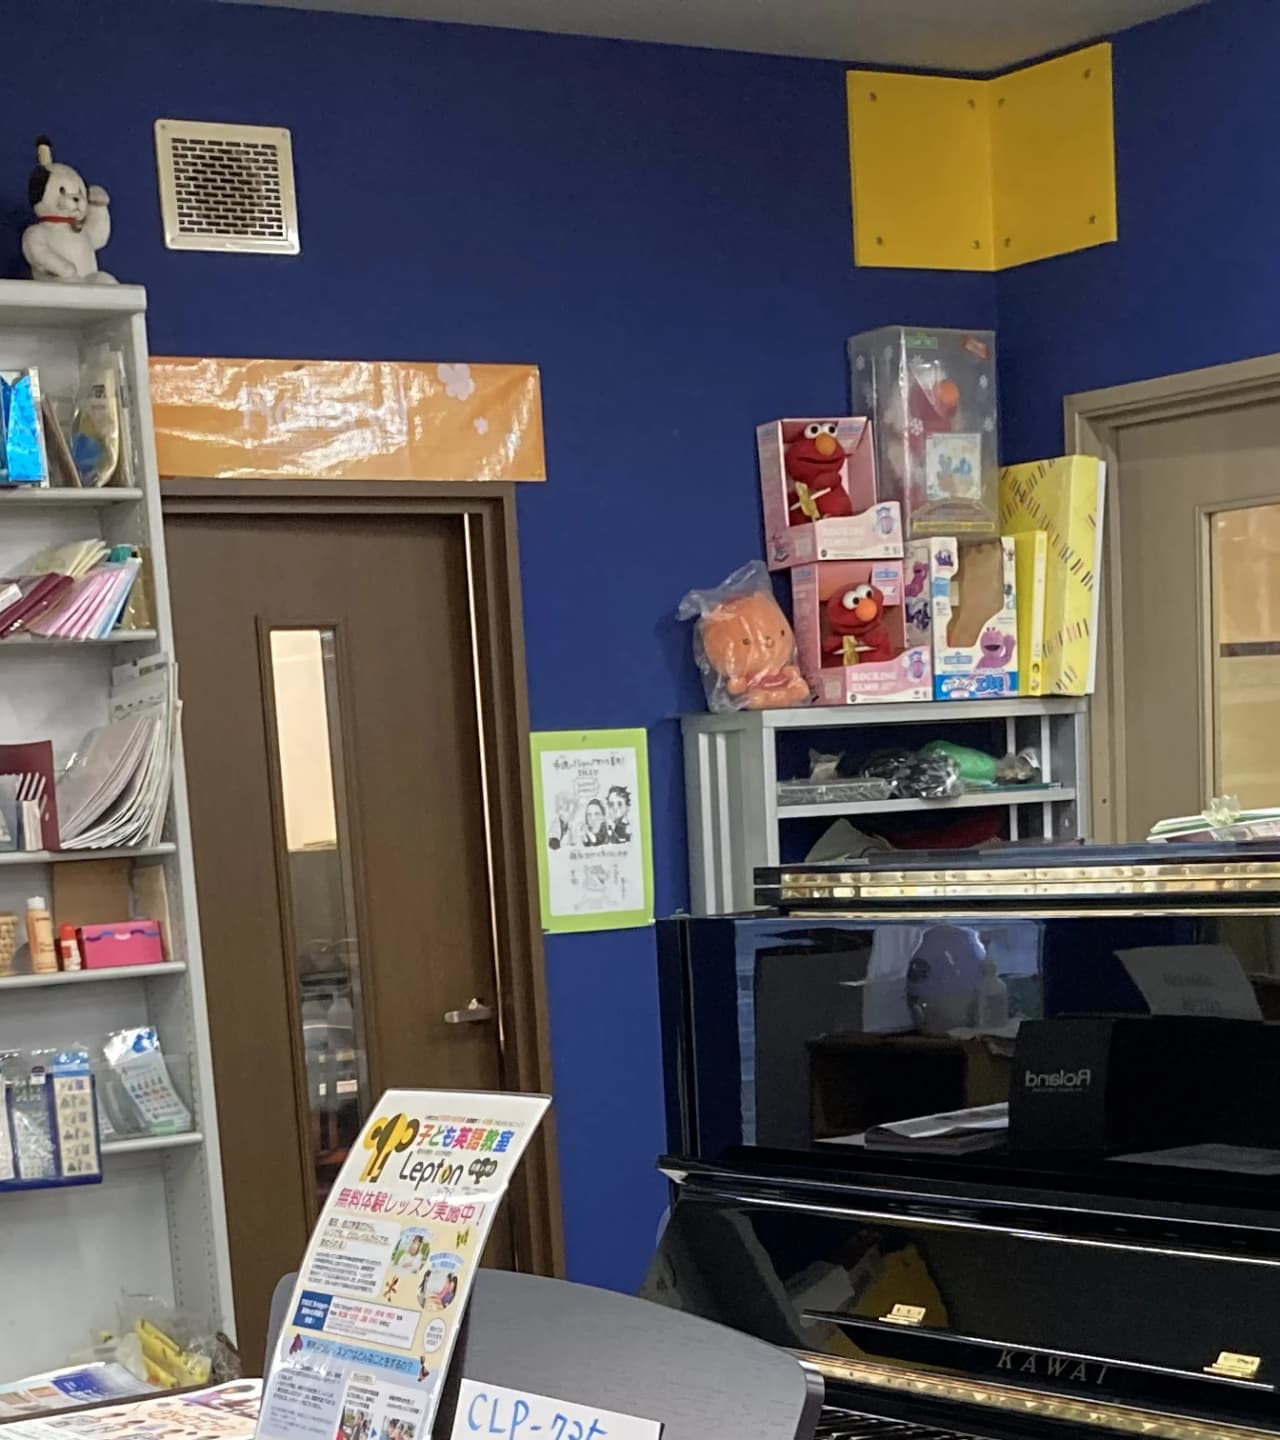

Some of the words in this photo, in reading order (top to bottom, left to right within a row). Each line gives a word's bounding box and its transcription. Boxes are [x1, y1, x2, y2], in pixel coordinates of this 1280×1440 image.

[416, 1124, 515, 1153] 子ども英語教室
[399, 1151, 465, 1190] Lepton
[997, 1350, 1107, 1385] KAWAI
